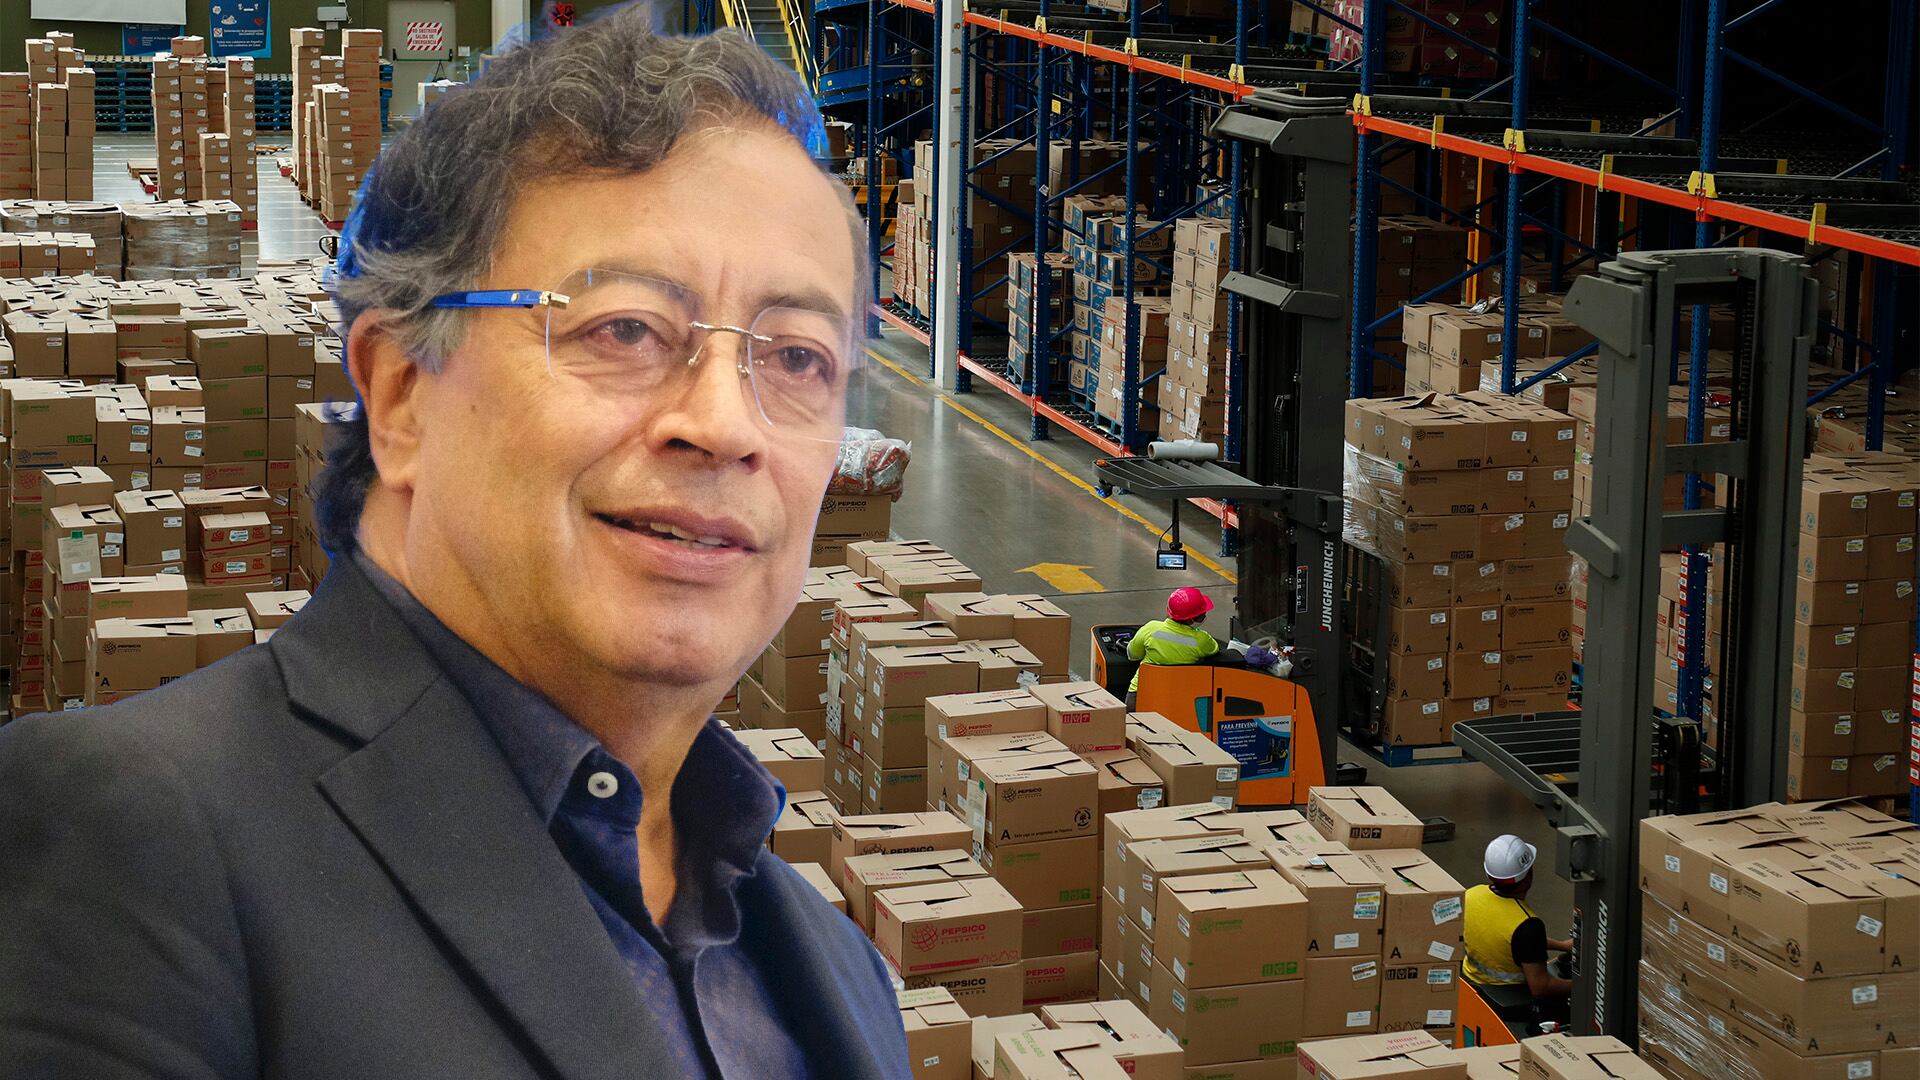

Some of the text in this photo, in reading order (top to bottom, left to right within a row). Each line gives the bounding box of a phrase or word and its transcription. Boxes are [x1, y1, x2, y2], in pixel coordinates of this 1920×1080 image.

[1320, 540, 1334, 632] JUNGHEINRICH
[1221, 723, 1234, 731] PARA
[1017, 787, 1043, 795] PEPSICO
[1001, 829, 1011, 841] A
[941, 923, 986, 936] PEPSICO
[1308, 939, 1319, 951] A
[1390, 946, 1402, 959] A
[1594, 899, 1608, 1035] JUNGHEINRICH
[1891, 954, 1902, 968] A
[1025, 966, 1066, 977] PEPSICO
[1812, 961, 1824, 975] A
[940, 977, 986, 989] PEPSICO
[1807, 1037, 1819, 1051] A
[1885, 1031, 1897, 1045] A
